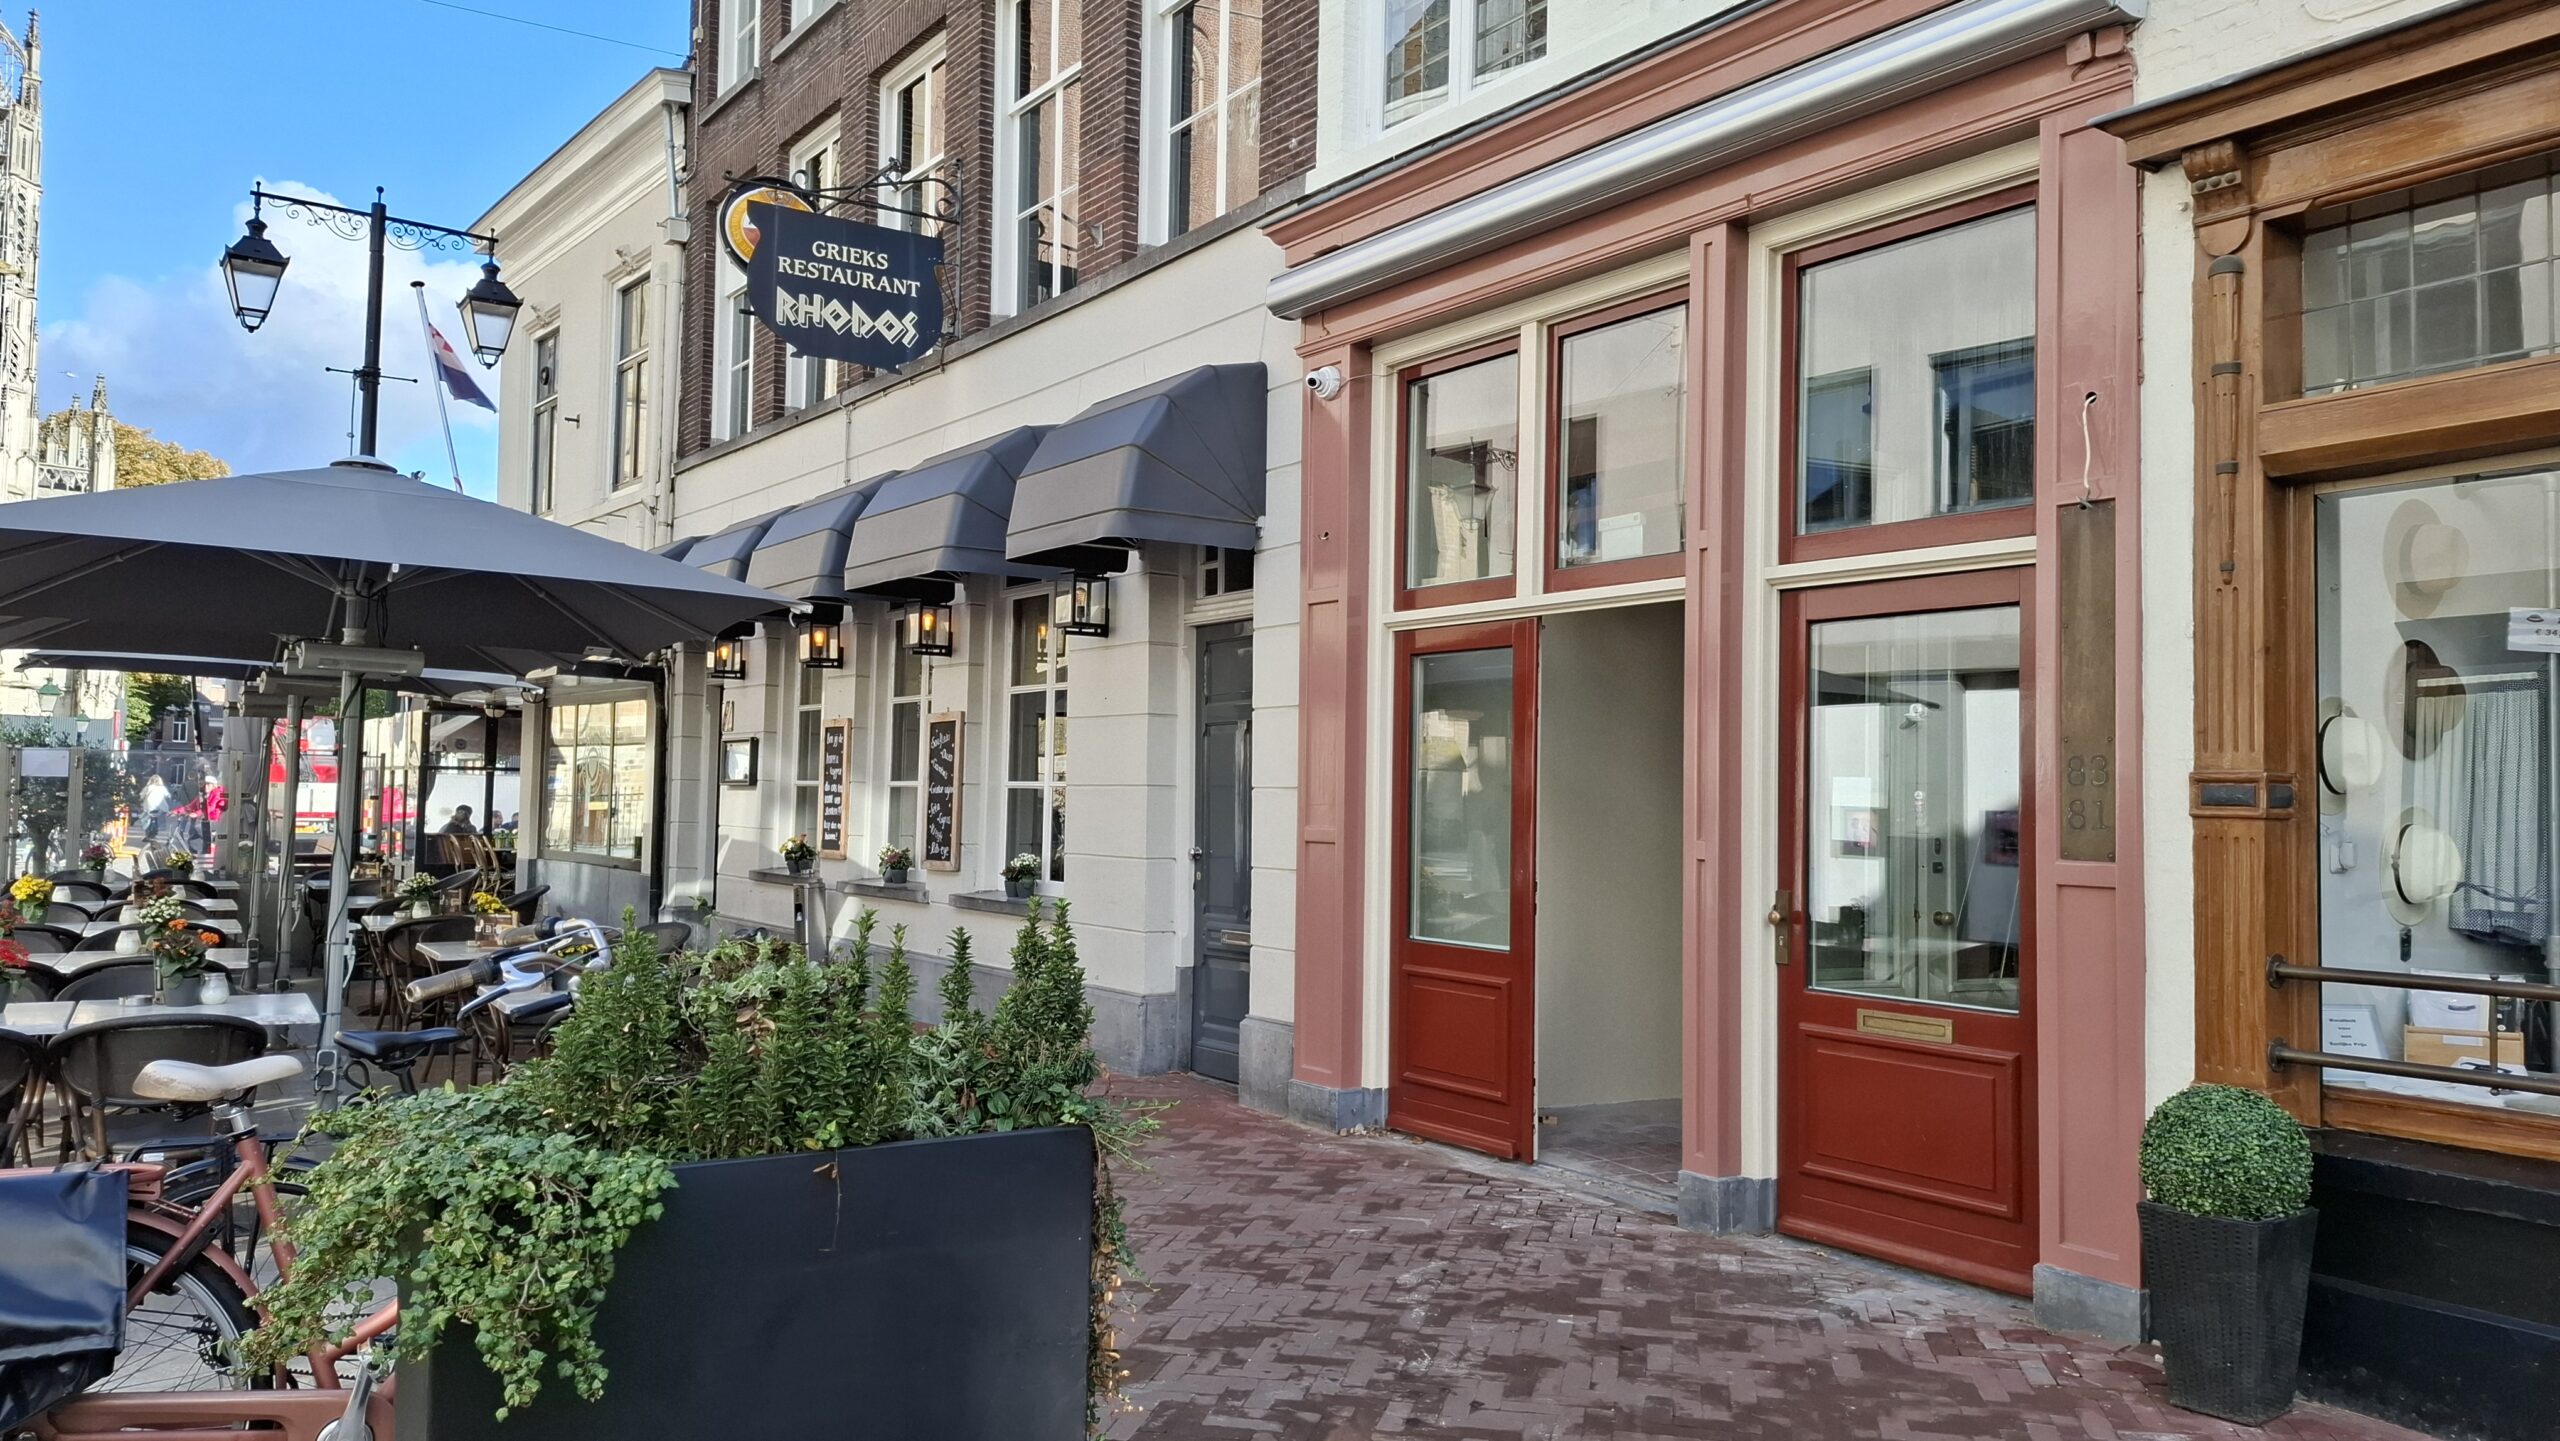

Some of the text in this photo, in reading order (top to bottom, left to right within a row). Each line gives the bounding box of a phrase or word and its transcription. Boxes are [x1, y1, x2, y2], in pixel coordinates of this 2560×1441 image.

[812, 240, 888, 270] GRIEKS
[777, 256, 921, 298] RESTAURANT
[776, 286, 919, 348] RHODOS
[2068, 755, 2109, 787] 83
[2068, 799, 2111, 831] 81
